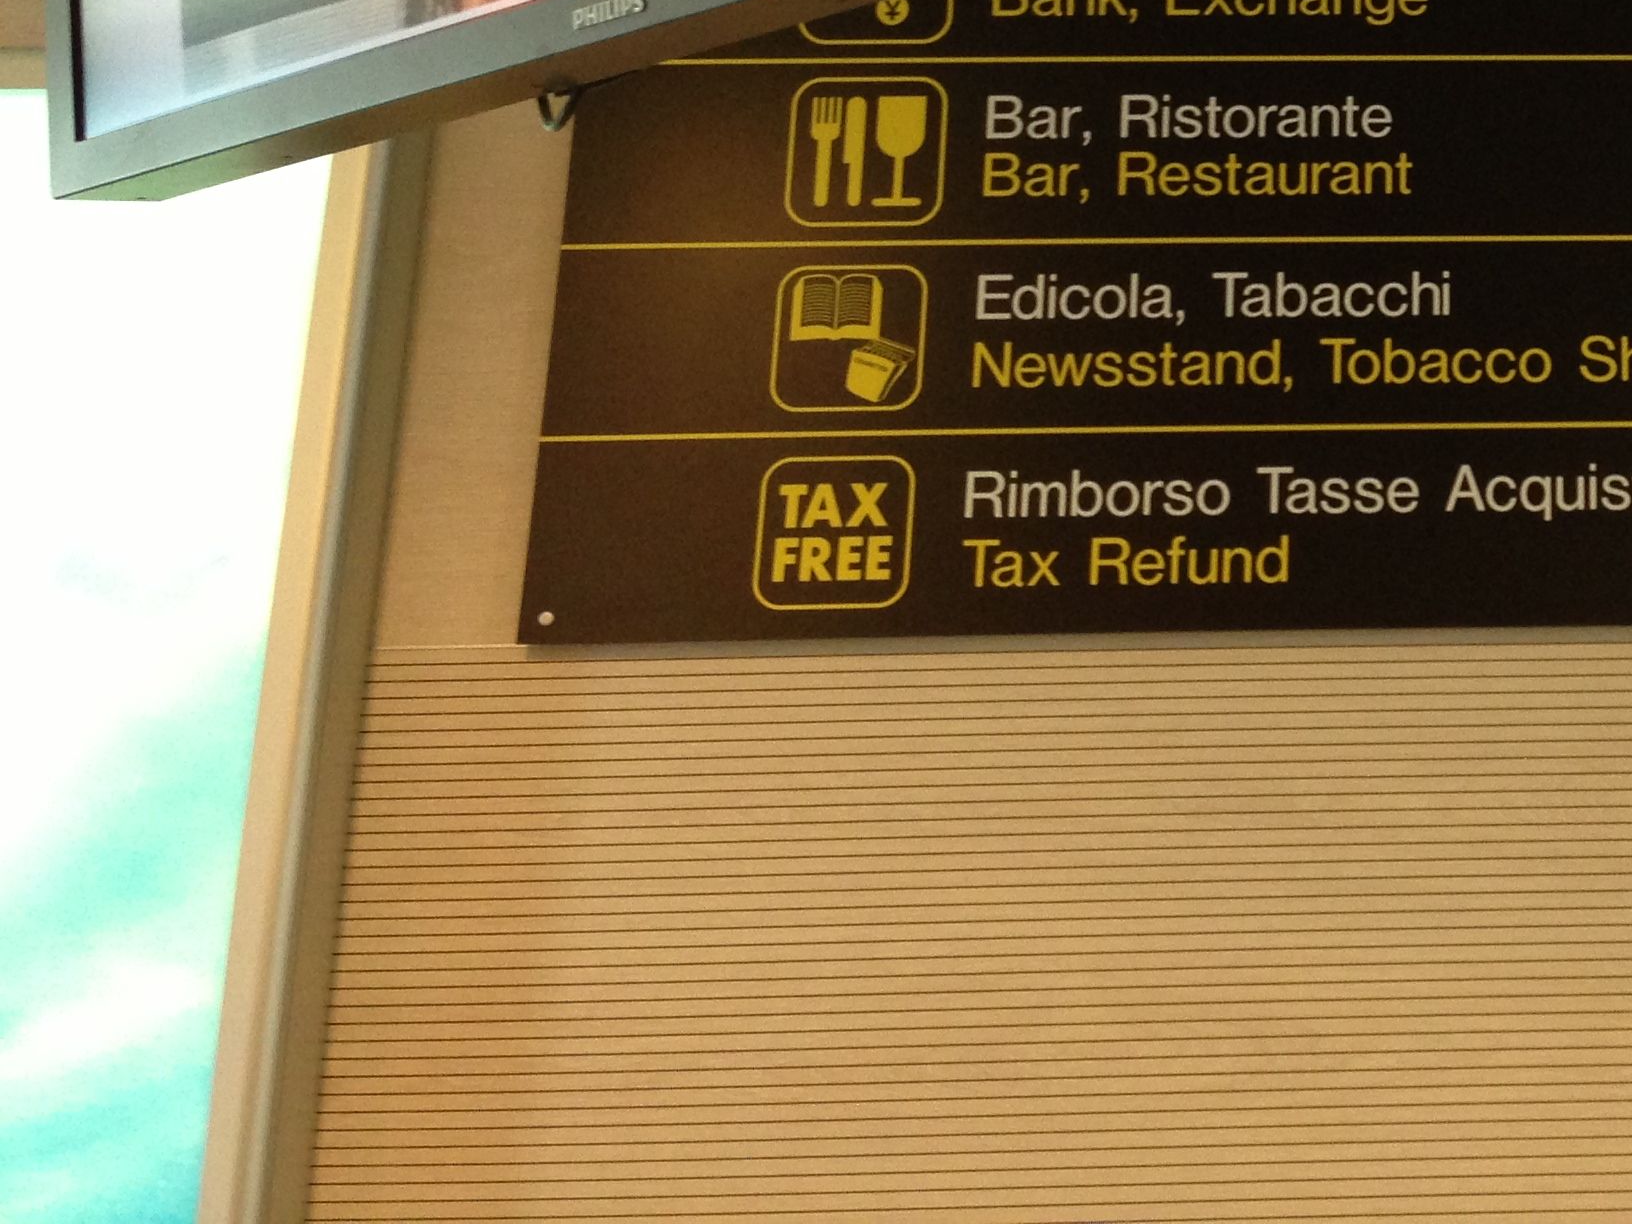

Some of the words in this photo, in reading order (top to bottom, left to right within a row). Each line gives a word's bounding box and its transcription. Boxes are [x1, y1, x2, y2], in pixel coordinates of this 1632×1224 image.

[985, 95, 1092, 146] Bar,
[1120, 94, 1393, 139] Ristorante
[982, 152, 1089, 204] Bar,
[1118, 151, 1413, 197] Restaurant
[975, 272, 1185, 326] Edicola,
[1212, 270, 1450, 318] Tabacchi
[971, 338, 1293, 392] Newsstand,
[1319, 337, 1552, 385] Tobacco
[779, 482, 888, 528] TAX
[963, 469, 1231, 519] Rimborso
[1256, 466, 1420, 514] Tasse
[771, 535, 893, 582] FREE
[962, 538, 1061, 588] Tax
[1089, 534, 1290, 586] Refund
